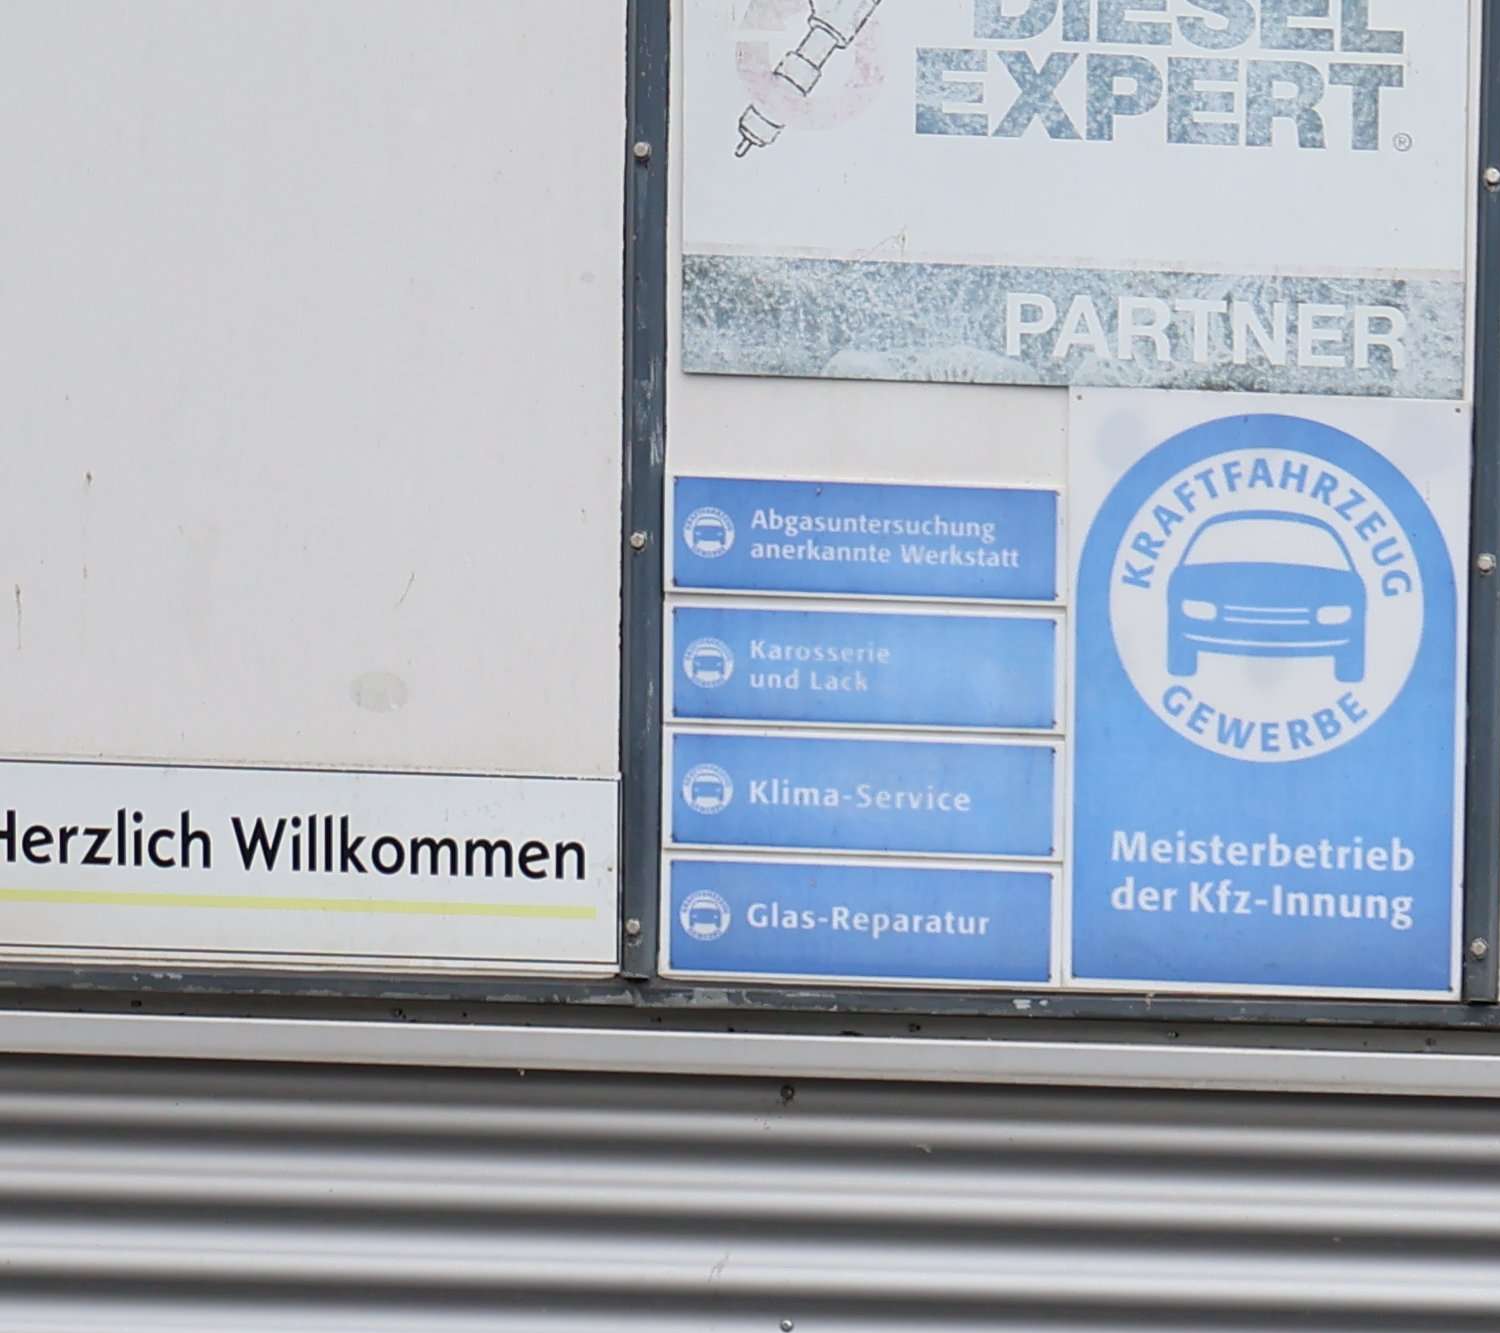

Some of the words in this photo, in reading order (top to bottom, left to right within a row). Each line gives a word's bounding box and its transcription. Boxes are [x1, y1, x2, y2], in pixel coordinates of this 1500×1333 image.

[915, 47, 1404, 151] EXPERT
[1005, 293, 1407, 371] PARTNER
[751, 509, 997, 544] Abgasuntersuchung
[1121, 457, 1415, 599] KRAFTFAHRZEUG
[751, 539, 891, 563] anerkannte
[901, 543, 1020, 569] Werkstatt
[751, 639, 891, 665] Karosserie
[750, 669, 800, 690] und
[810, 671, 869, 692] Lack
[1161, 684, 1371, 754] GEWERBE
[749, 780, 972, 813] Klima-Service
[230, 812, 587, 882] Willkommen
[1111, 830, 1416, 873] Meisterbetrieb
[746, 901, 991, 939] Glas-Reparatur
[1111, 878, 1178, 914] der
[1189, 881, 1415, 931] Kfz-Innung
